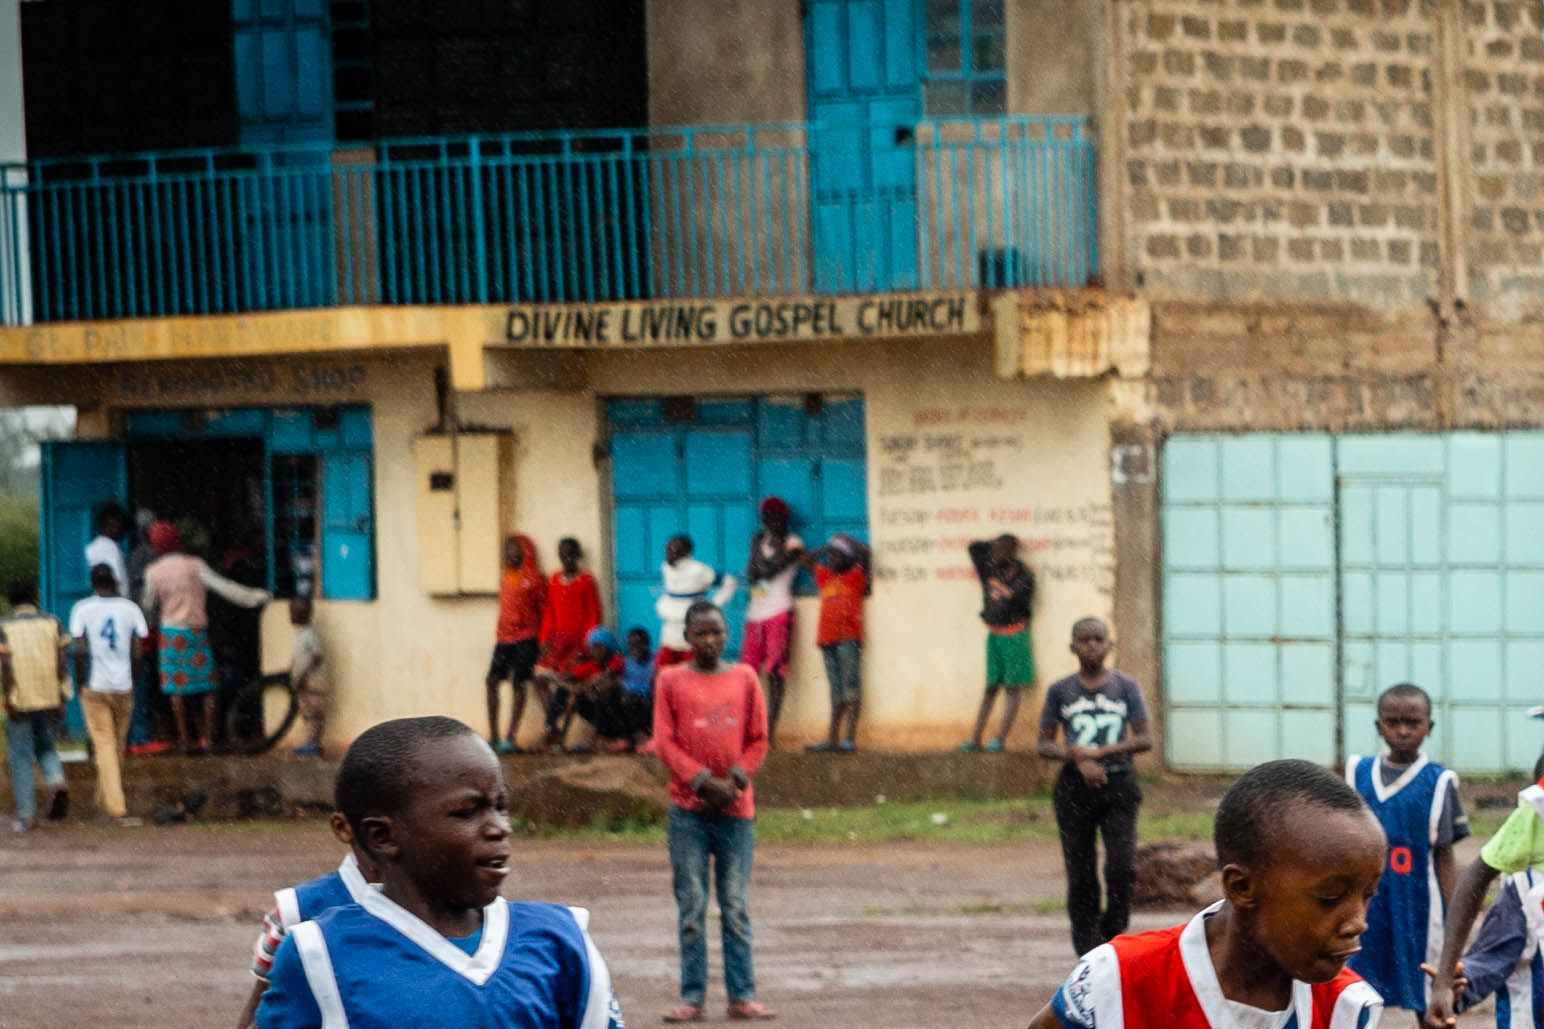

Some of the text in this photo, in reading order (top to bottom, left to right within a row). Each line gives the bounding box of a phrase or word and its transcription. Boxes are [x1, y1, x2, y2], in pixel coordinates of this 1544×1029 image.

[505, 295, 966, 343] DIVINE LIVING GOSPEL CHURCH
[100, 617, 120, 650] 4
[1071, 713, 1123, 749] 27
